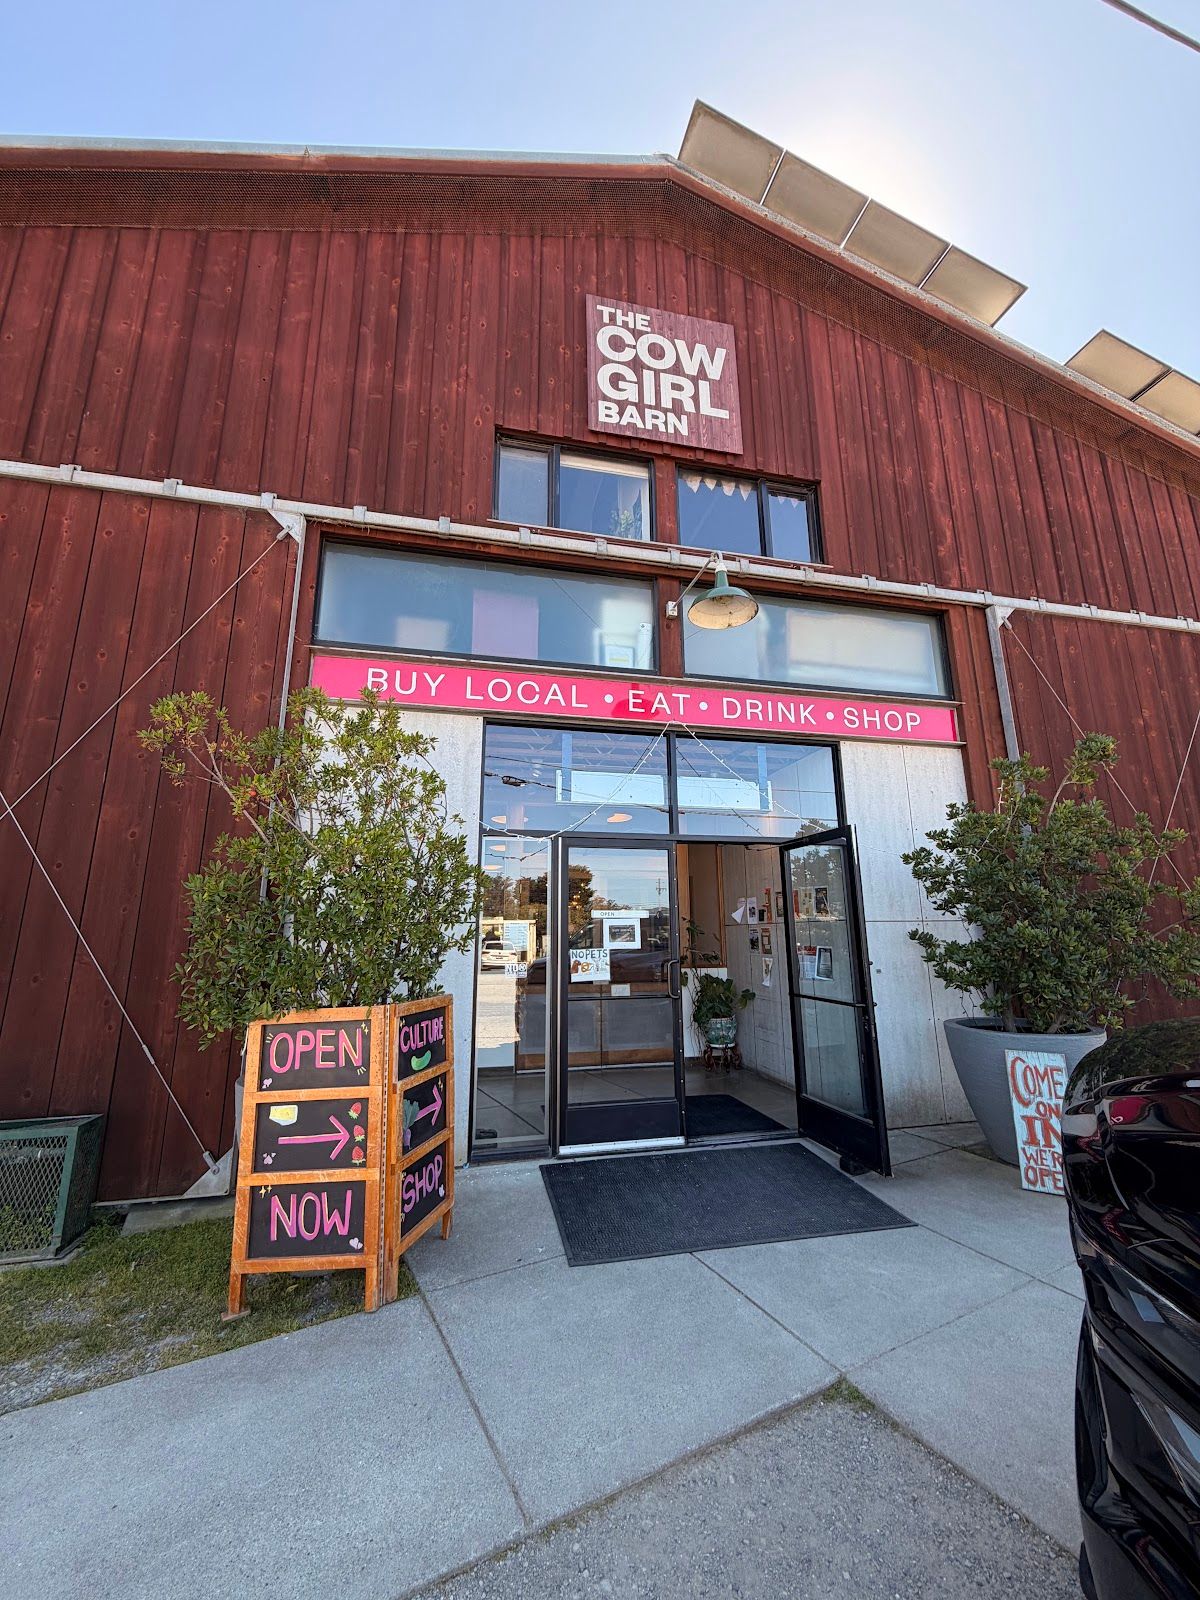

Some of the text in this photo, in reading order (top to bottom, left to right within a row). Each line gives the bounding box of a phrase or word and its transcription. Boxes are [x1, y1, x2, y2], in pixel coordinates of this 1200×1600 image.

[596, 304, 651, 332] THE
[596, 325, 727, 381] COW
[596, 362, 730, 420] GIRL
[597, 400, 689, 436] BARN
[366, 667, 921, 733] BUY LOCAL EAT DRINK SHOP
[269, 1027, 363, 1074] OPEN
[400, 1016, 444, 1053] CULTURE
[1010, 1056, 1064, 1108] COME
[1035, 1101, 1062, 1121] ON
[1021, 1147, 1063, 1169] WE'R
[1024, 1165, 1064, 1191] OPE
[401, 1154, 443, 1214] SHOP
[270, 1189, 353, 1241] NOW
